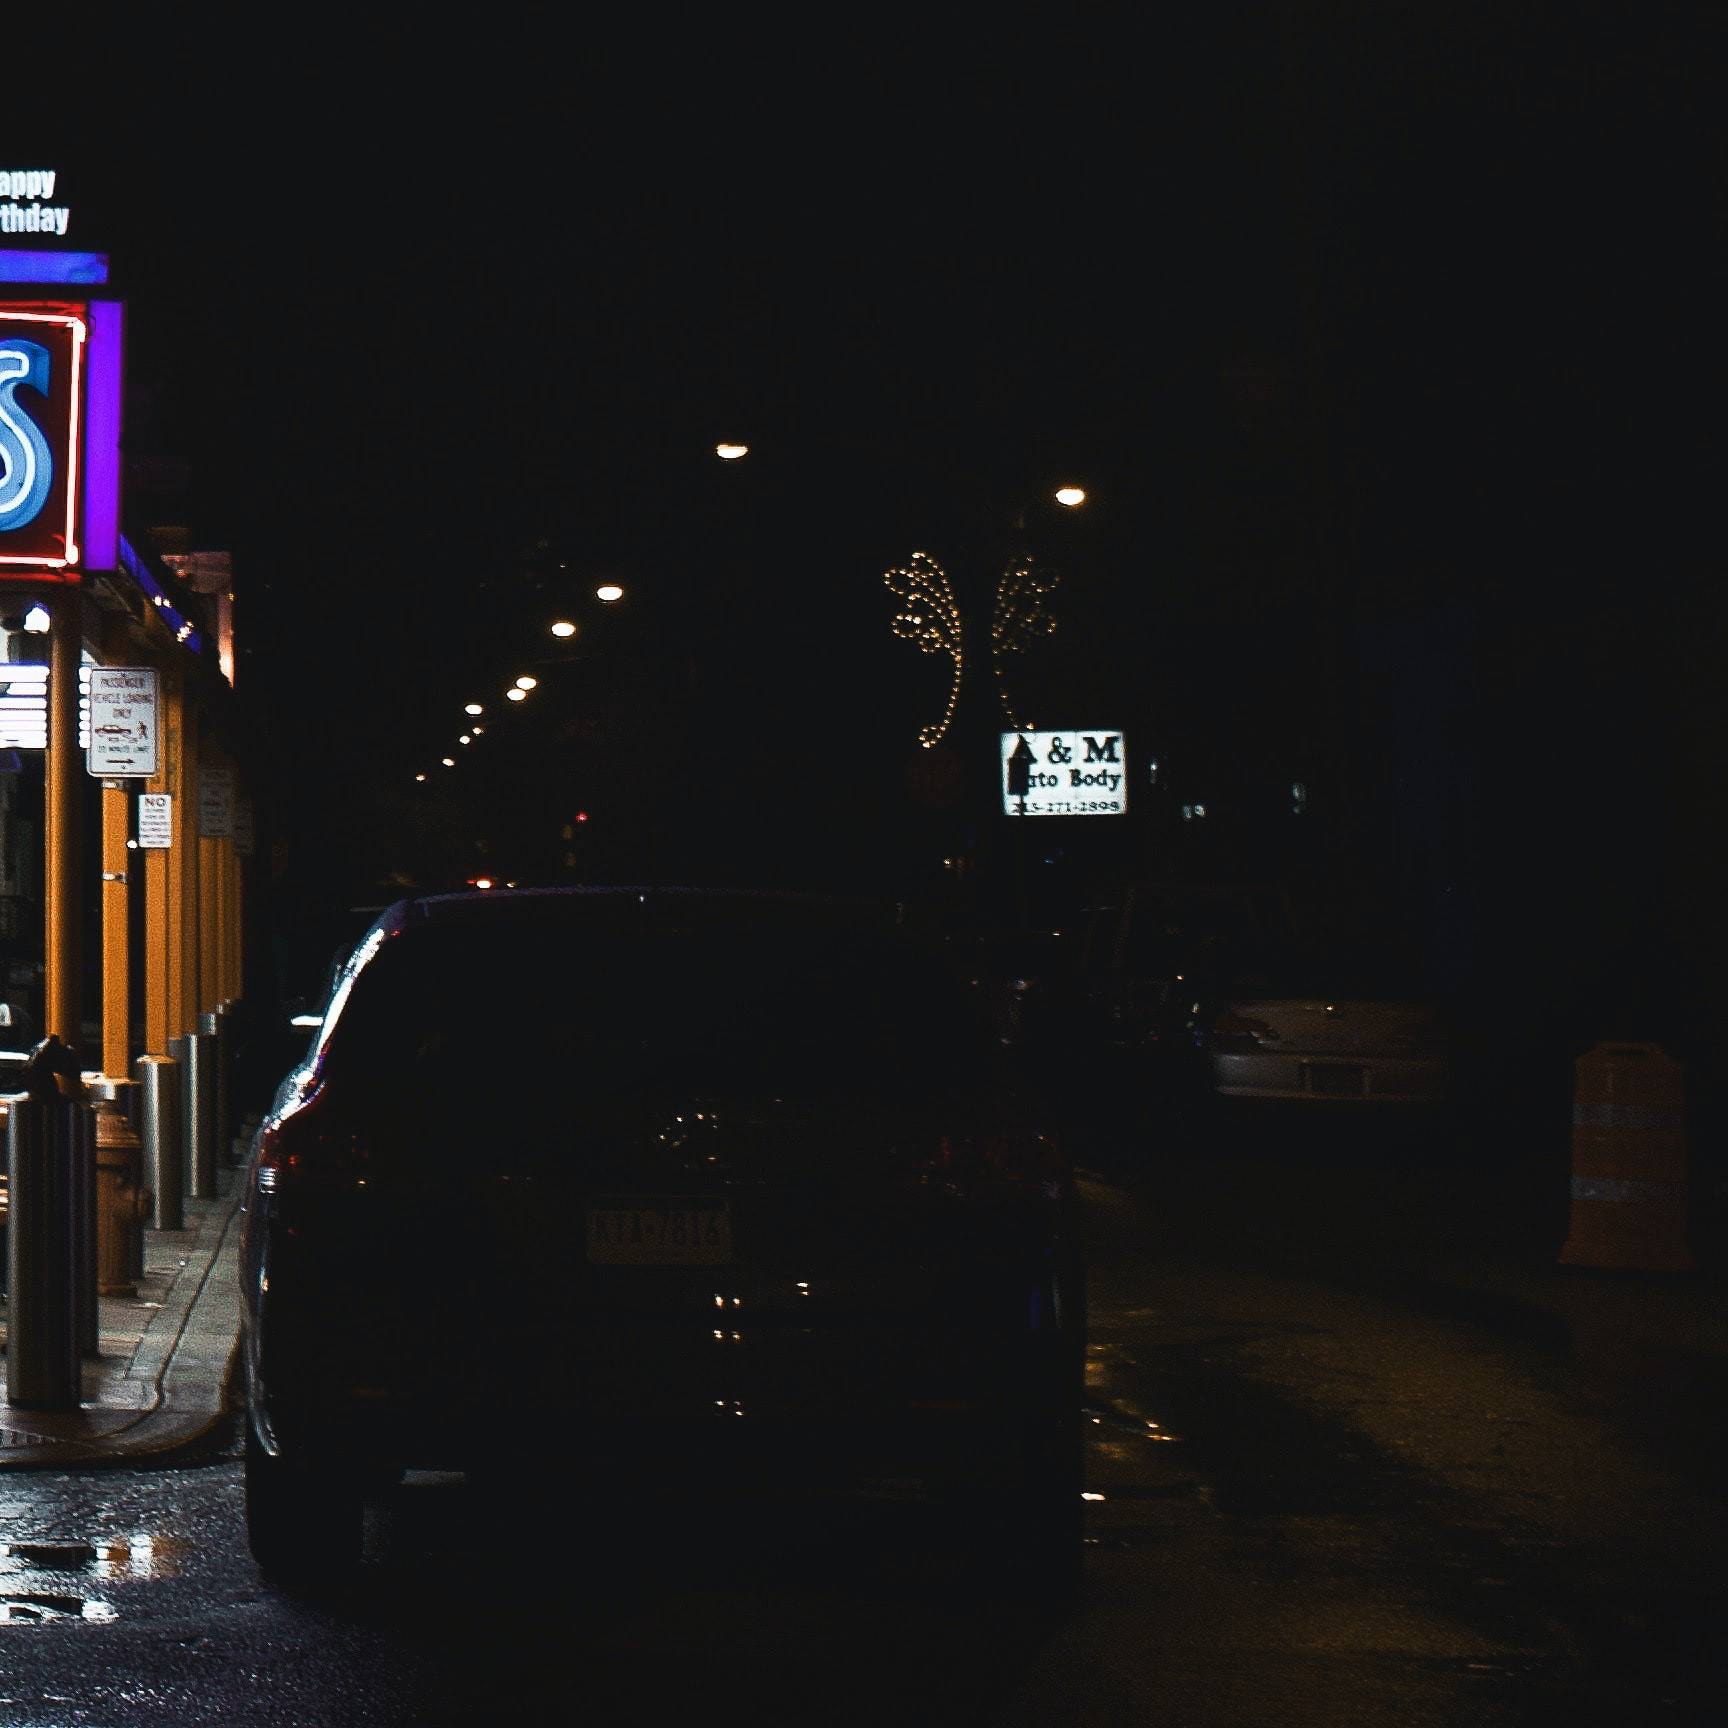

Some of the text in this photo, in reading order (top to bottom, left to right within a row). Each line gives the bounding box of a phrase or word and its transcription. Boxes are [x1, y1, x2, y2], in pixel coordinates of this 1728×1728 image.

[1048, 736, 1071, 764] &
[1083, 736, 1121, 763] M
[1069, 768, 1121, 792] Body
[144, 797, 166, 807] NO
